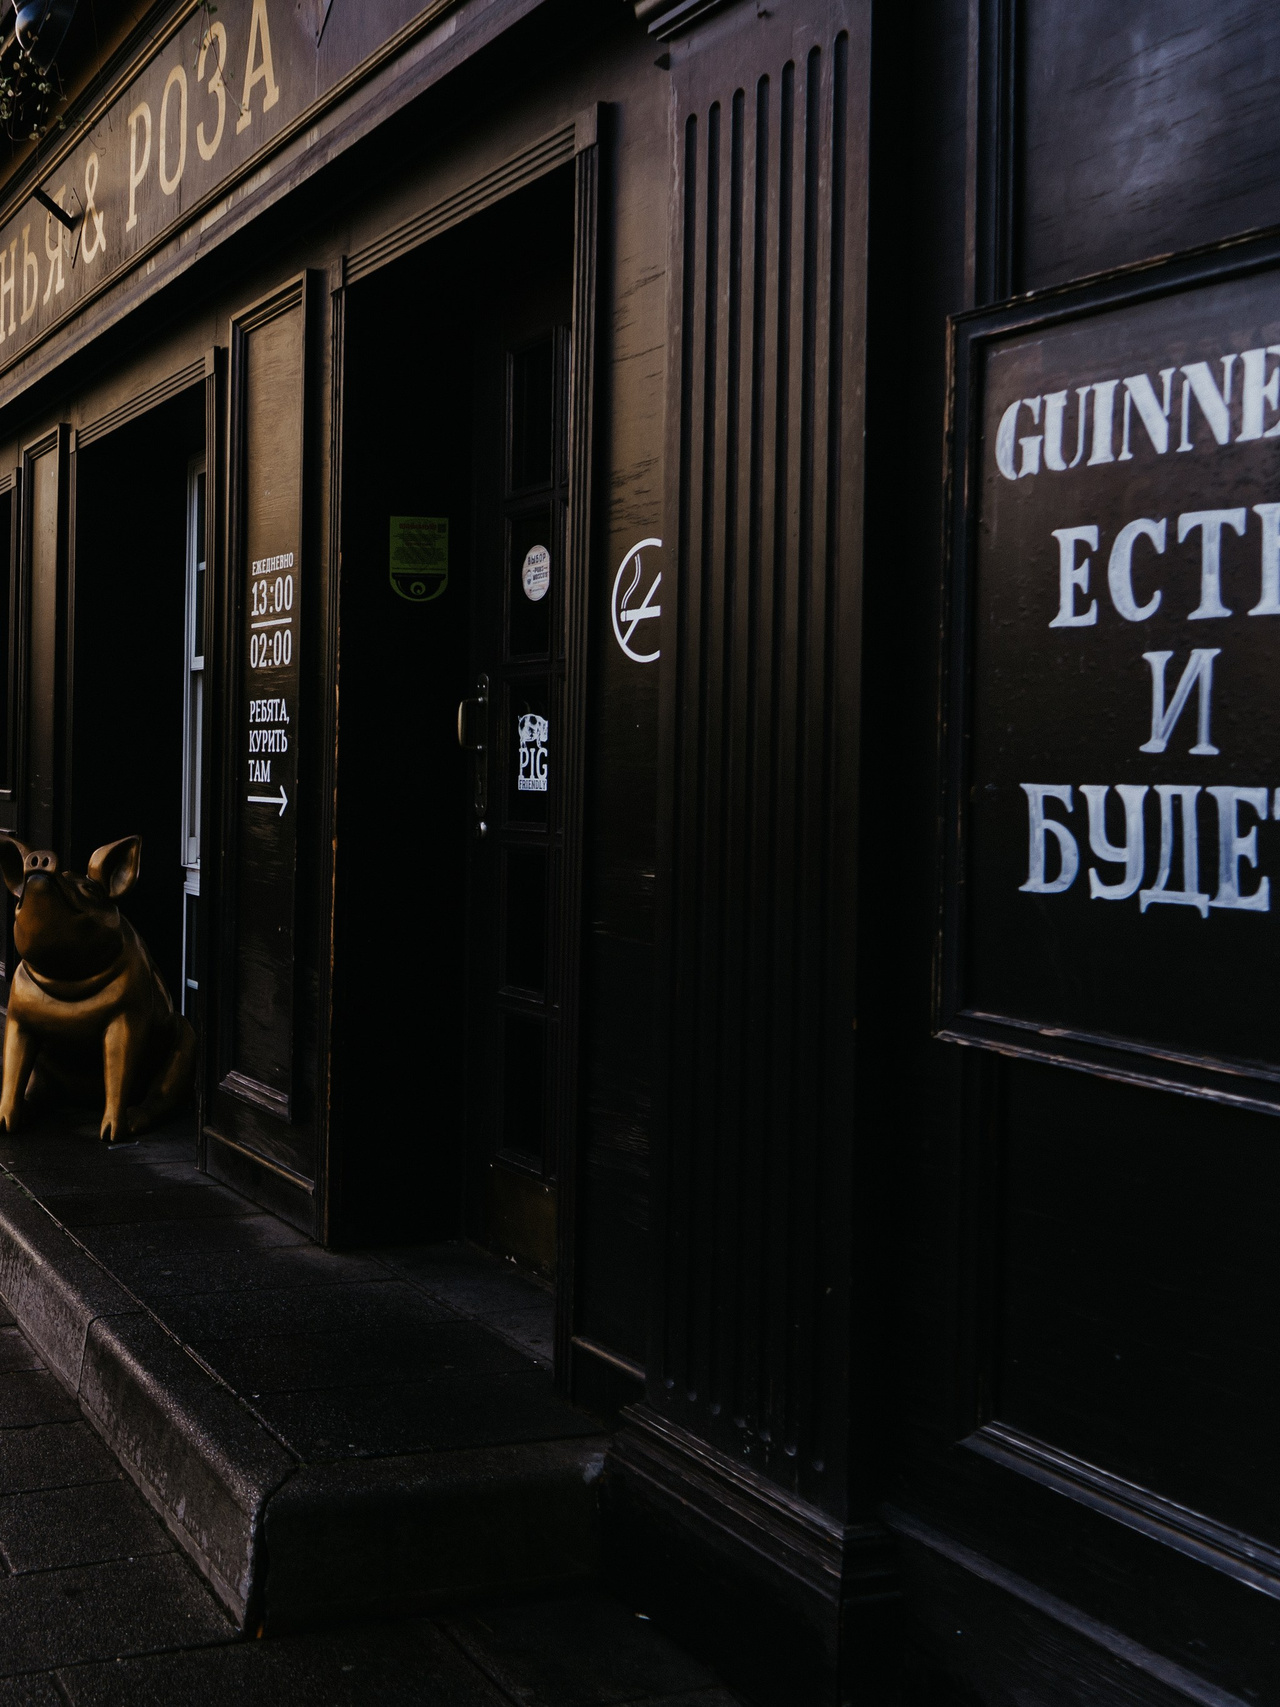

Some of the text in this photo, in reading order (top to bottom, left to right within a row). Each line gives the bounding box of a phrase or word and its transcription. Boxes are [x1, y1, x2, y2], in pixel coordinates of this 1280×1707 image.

[81, 152, 107, 264] &
[126, 0, 279, 232] РОЗА
[995, 344, 1280, 481] GUINNE
[252, 552, 293, 576] ЕЖЕДНЕВНО
[251, 574, 293, 616] 13:00
[250, 629, 292, 669] 02:00
[249, 698, 290, 724] РЕБЯТА,
[1139, 648, 1221, 755] И
[248, 729, 288, 752] КУРИТЬ
[248, 759, 271, 783] ТАМ
[518, 747, 548, 780] PIG
[519, 778, 547, 789] FRIENDLY
[1018, 782, 1280, 918] БУДЕ
